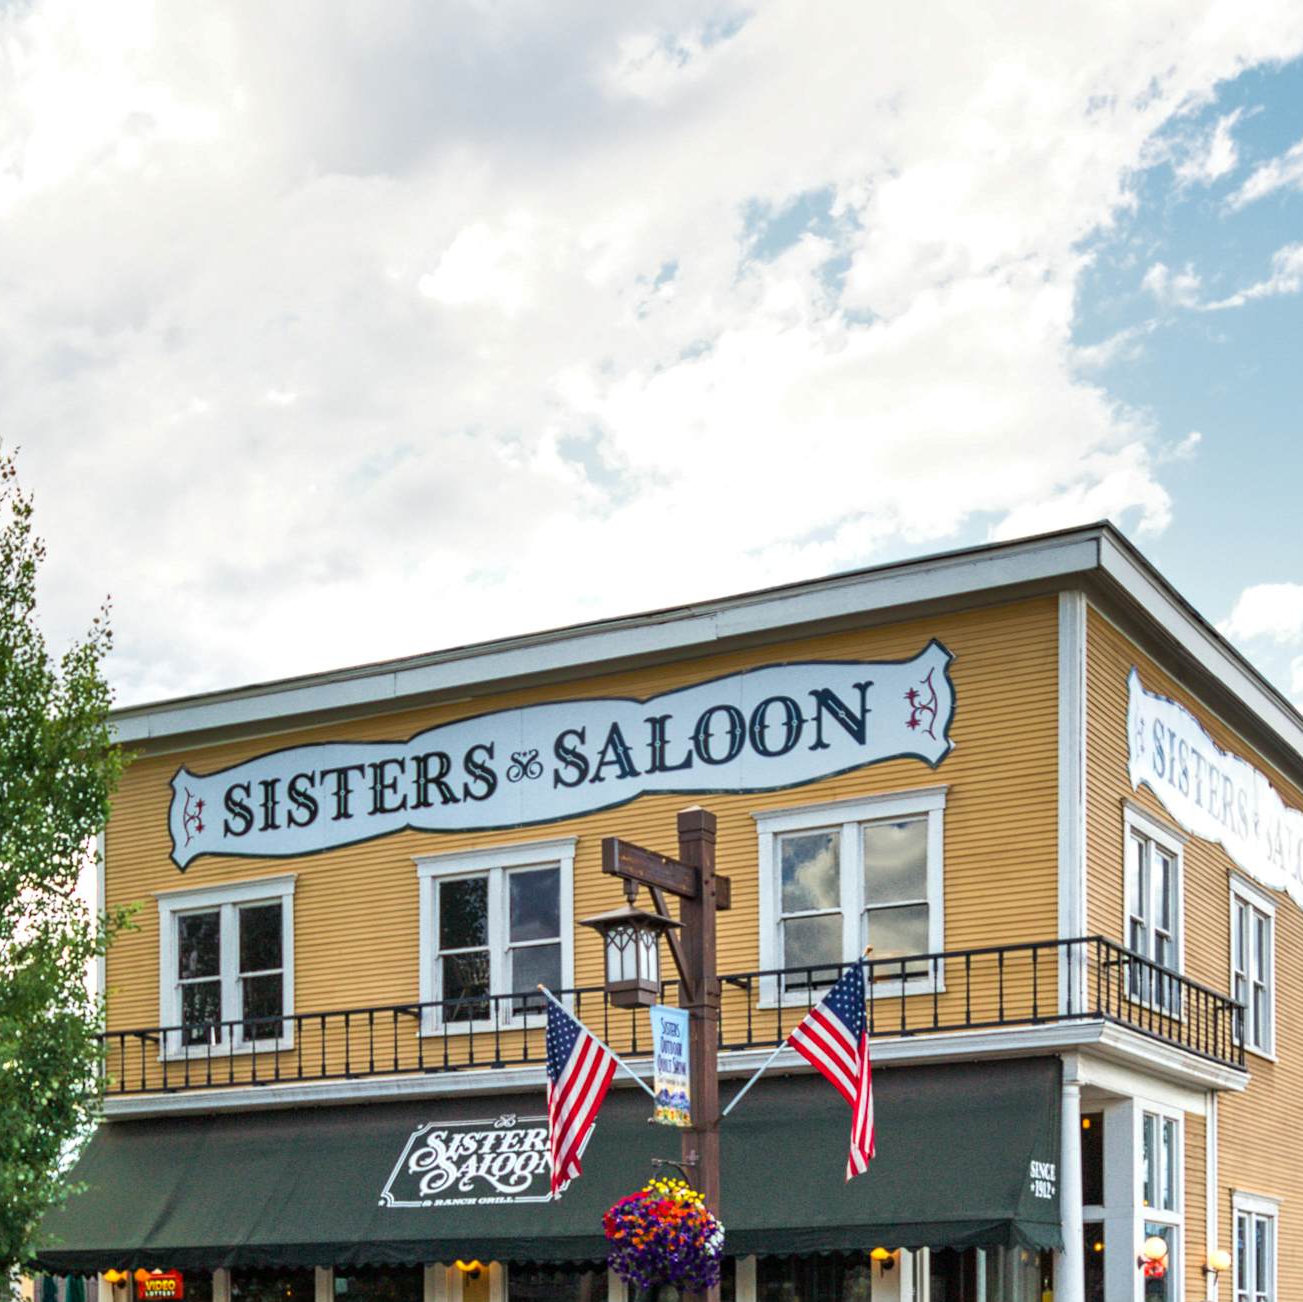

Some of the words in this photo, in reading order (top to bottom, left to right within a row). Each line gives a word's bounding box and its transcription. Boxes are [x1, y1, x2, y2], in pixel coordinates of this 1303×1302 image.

[223, 741, 499, 838] SISTERS
[553, 680, 875, 789] SALOON
[1152, 717, 1249, 842] SISTERS
[408, 1128, 551, 1175] SISTER
[1030, 1160, 1056, 1181] SINCE
[434, 1198, 477, 1207] RANCH
[478, 1196, 514, 1205] GRILL
[145, 1280, 176, 1291] VIDEO
